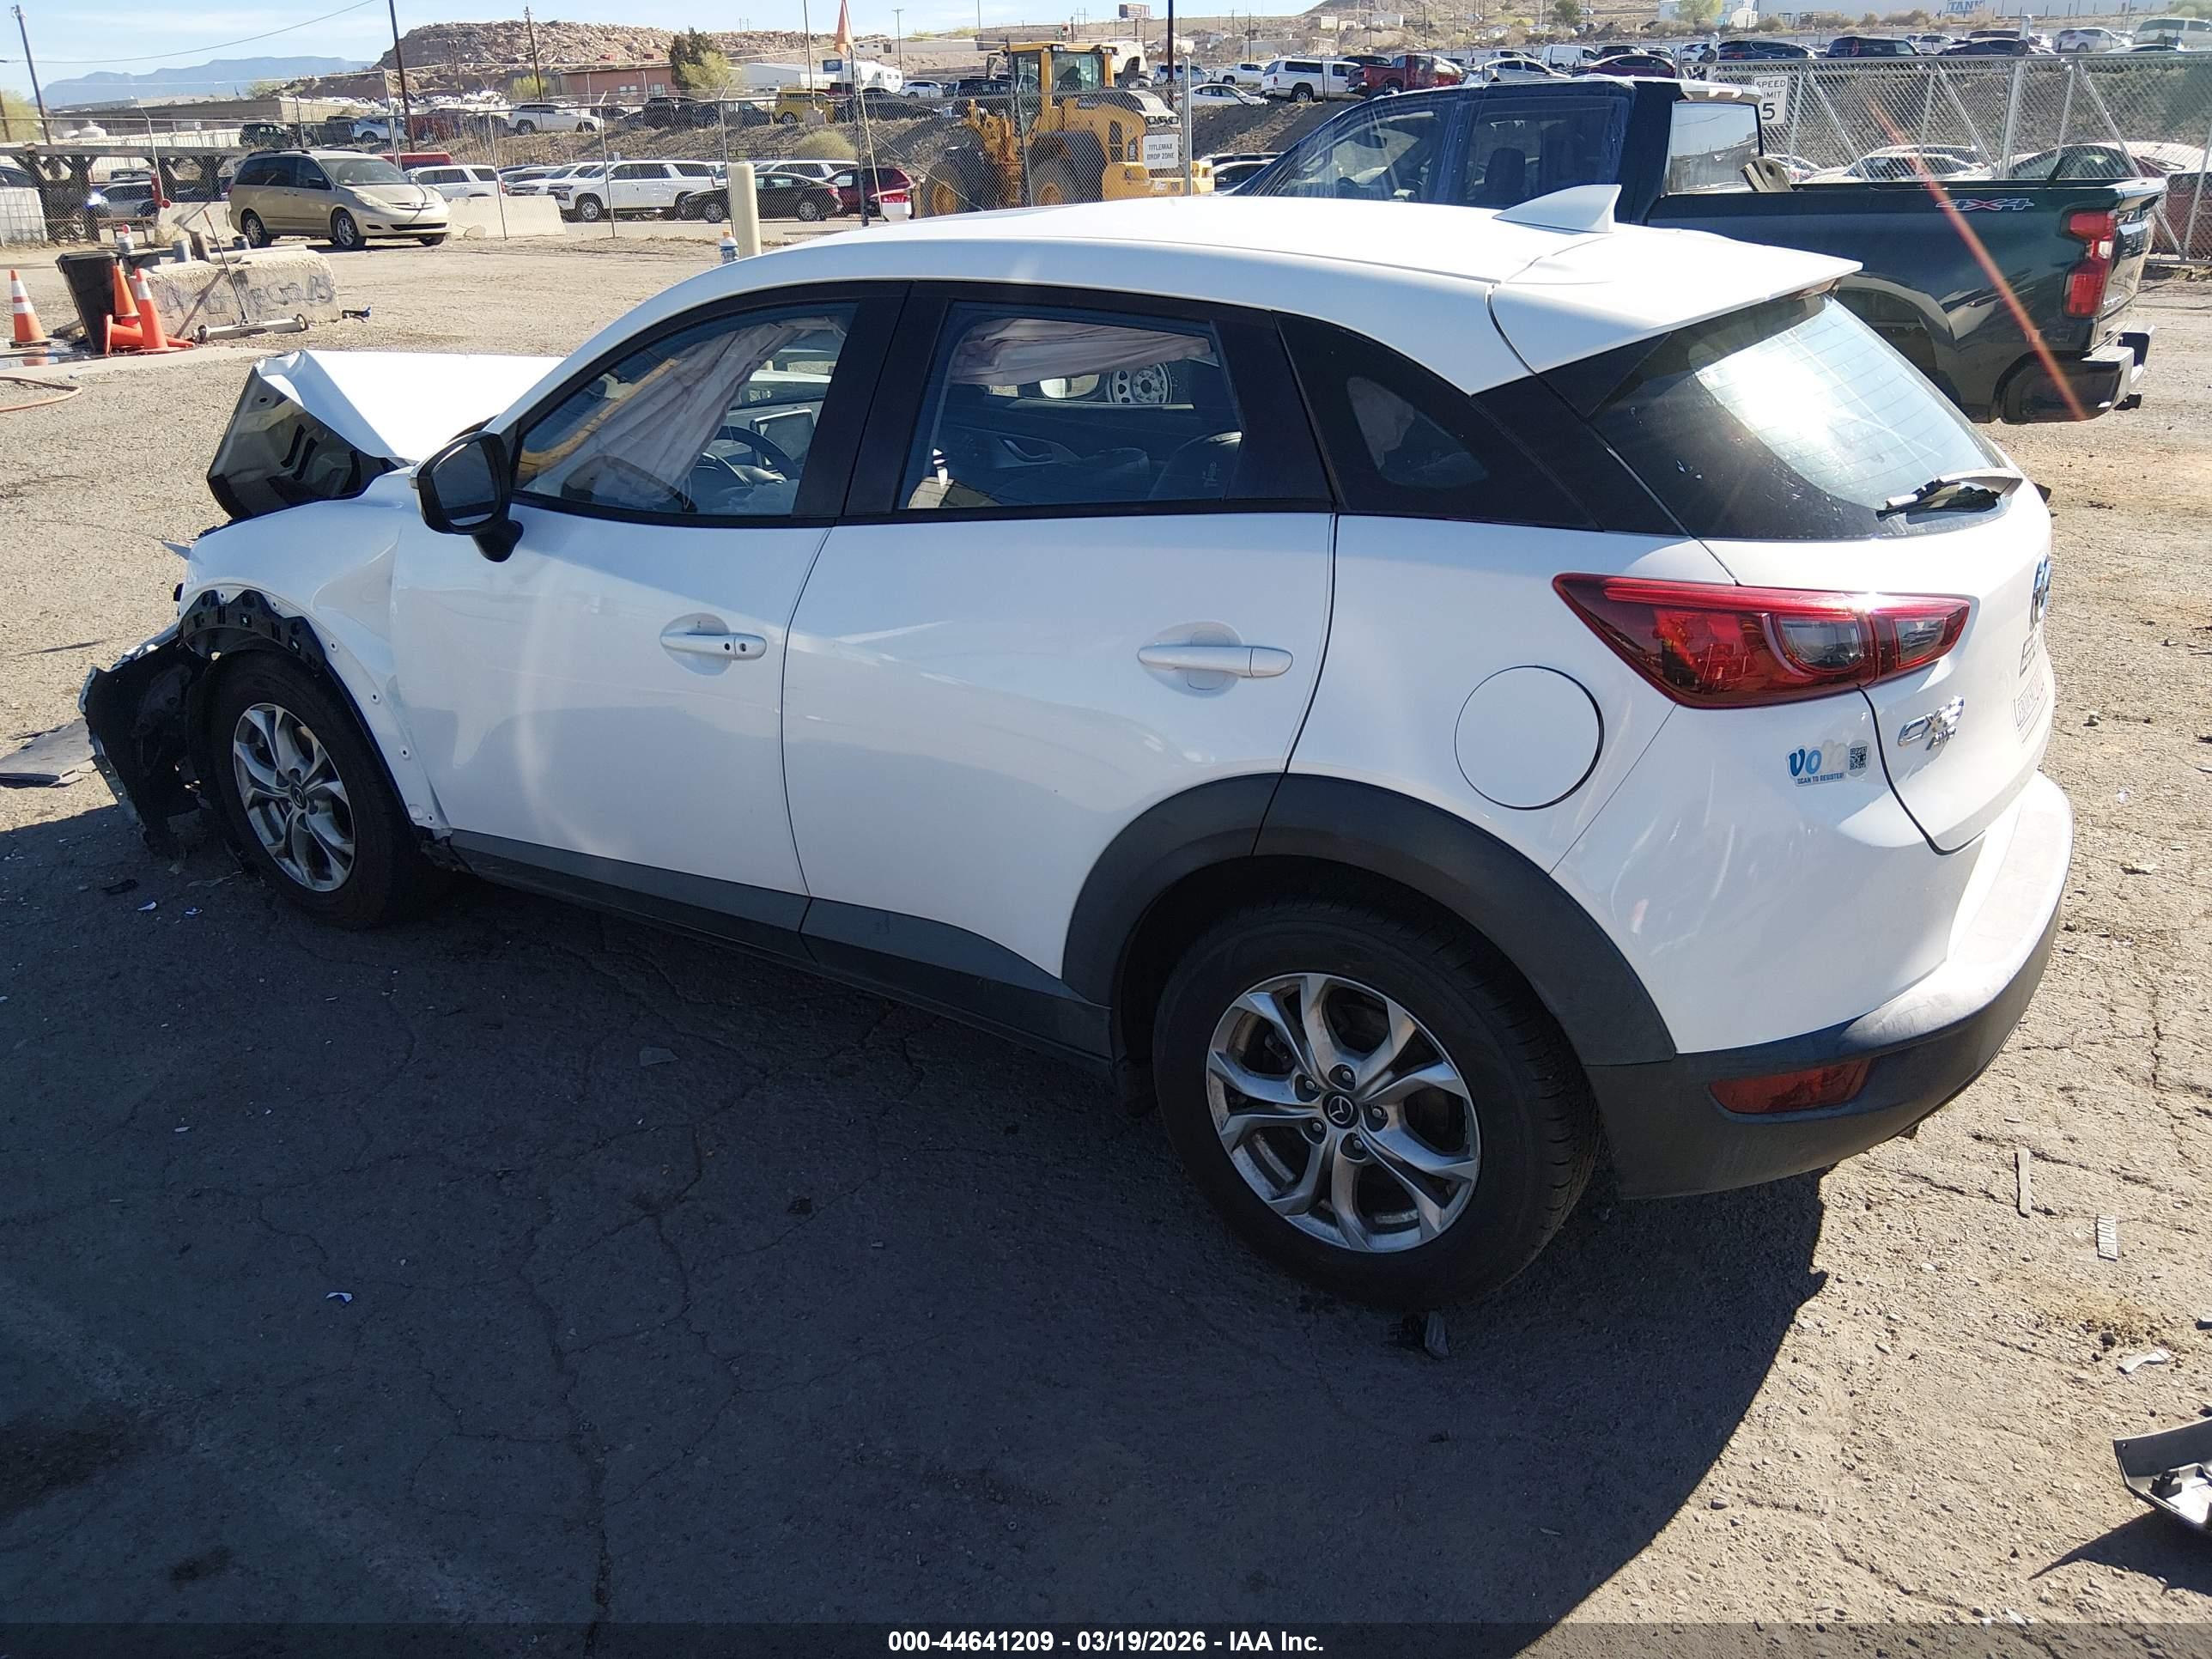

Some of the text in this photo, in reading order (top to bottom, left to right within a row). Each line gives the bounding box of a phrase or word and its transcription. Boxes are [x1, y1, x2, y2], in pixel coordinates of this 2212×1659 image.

[1756, 80, 1786, 88] SPEED
[1763, 90, 1782, 99] IMIT
[1761, 102, 1776, 120] 5
[1796, 776, 1811, 785] SCAN
